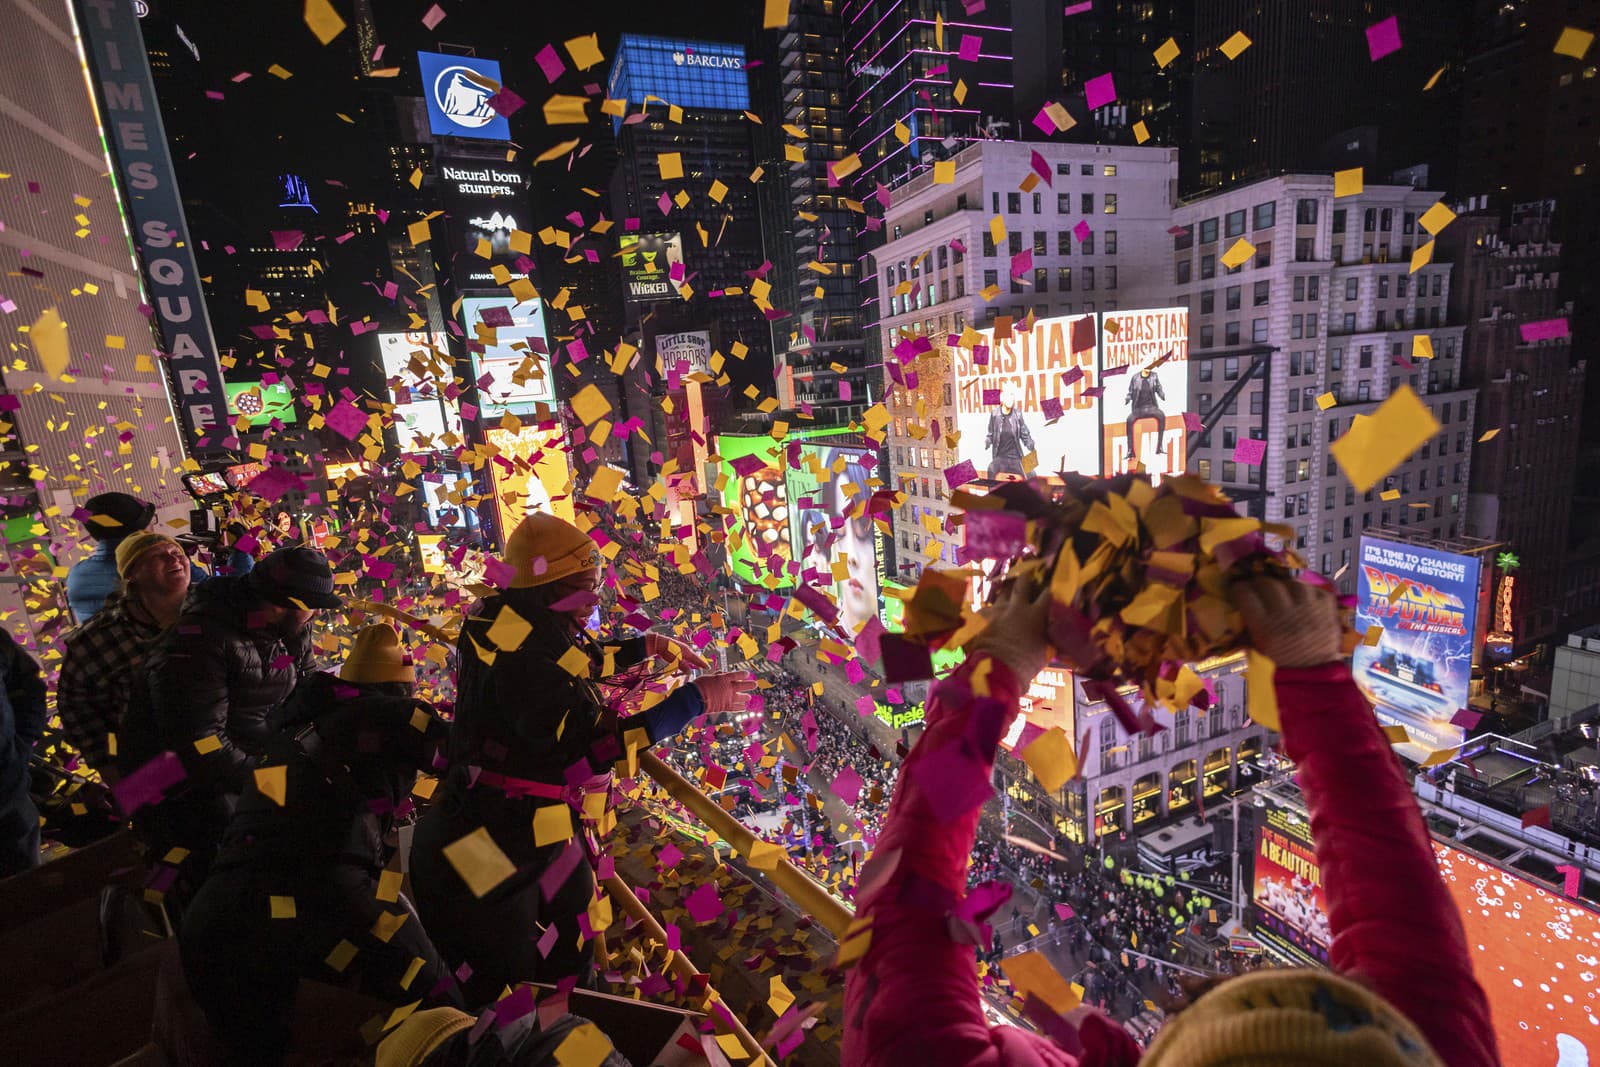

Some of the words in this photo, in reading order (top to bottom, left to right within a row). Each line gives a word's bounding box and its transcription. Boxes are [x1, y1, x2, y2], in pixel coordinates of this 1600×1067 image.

[686, 54, 741, 69] BARCLAYS
[442, 167, 490, 182] Natural
[459, 183, 515, 196] stunners.
[88, 0, 158, 190] TIMES
[142, 221, 217, 433] SQUARE
[661, 335, 686, 350] LITTLE
[687, 334, 706, 347] SHOP
[957, 321, 1093, 377] SASTIA
[959, 370, 1093, 413] MANALCO
[1364, 545, 1381, 555] IT'S
[1382, 548, 1404, 561] TIME
[1405, 553, 1419, 564] TO
[1421, 557, 1466, 574] CHANGE
[1364, 553, 1416, 571] BROADWAY
[1417, 564, 1465, 583] HISTORY!
[1361, 563, 1464, 609] BACK
[1370, 594, 1389, 609] TO
[1387, 600, 1465, 627] FUTURE
[1410, 622, 1425, 631] THE
[1426, 624, 1461, 635] MUSICAL
[893, 701, 925, 730] pelé
[1261, 837, 1268, 858] A
[1269, 841, 1322, 888] BEAUTIFUL
